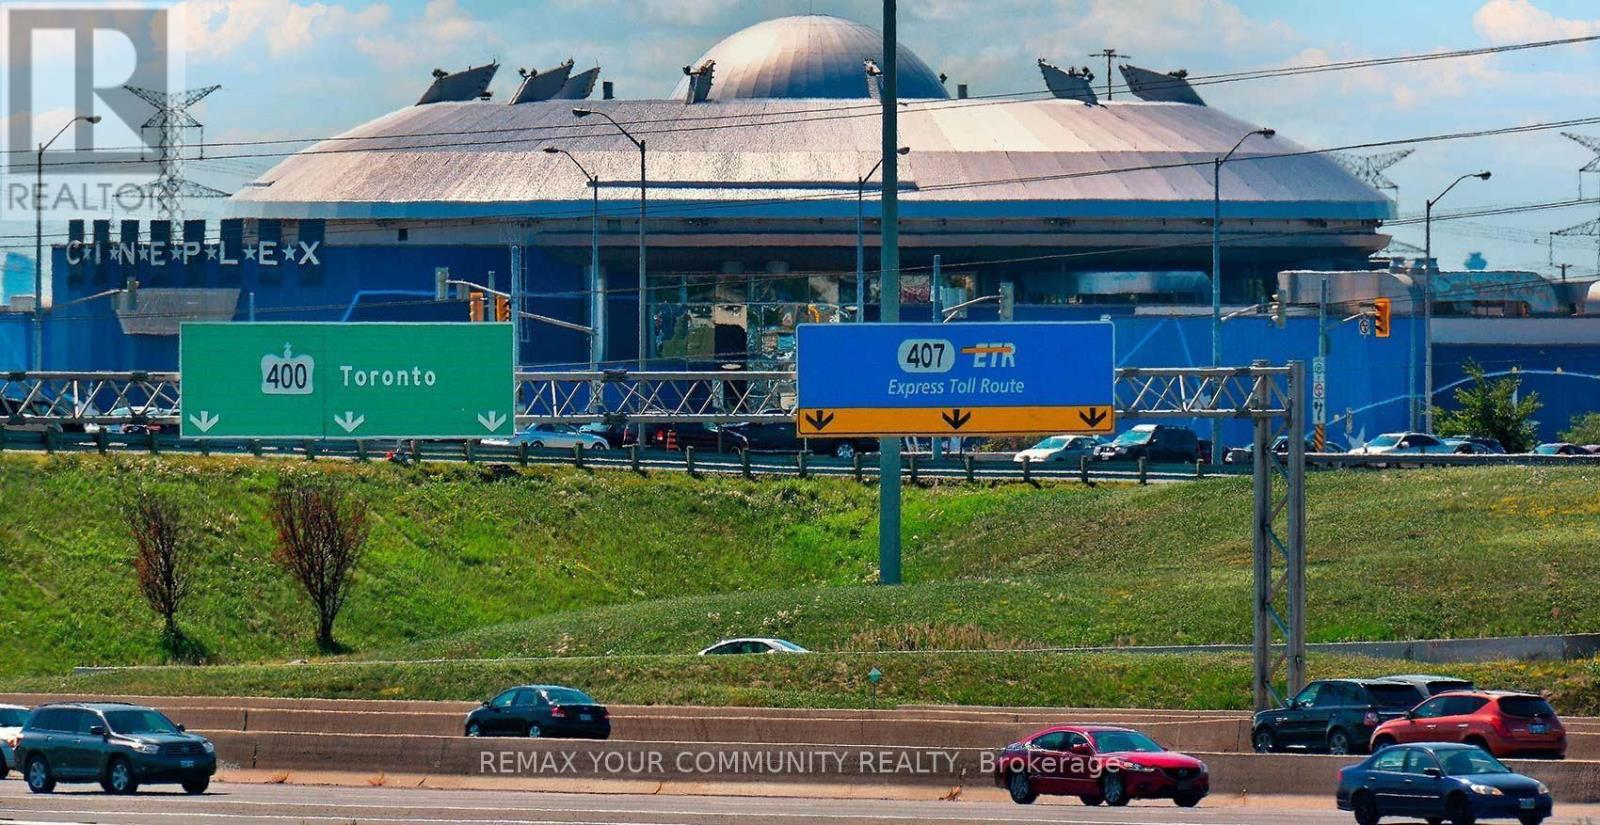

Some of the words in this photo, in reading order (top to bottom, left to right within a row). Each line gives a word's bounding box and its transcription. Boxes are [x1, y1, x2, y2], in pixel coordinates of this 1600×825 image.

[906, 342, 945, 368] 407
[973, 342, 1016, 368] ETR
[266, 363, 307, 389] 400
[339, 365, 436, 386] Toronto
[888, 379, 944, 398] Express
[950, 377, 976, 394] Toll
[980, 378, 1025, 394] Route
